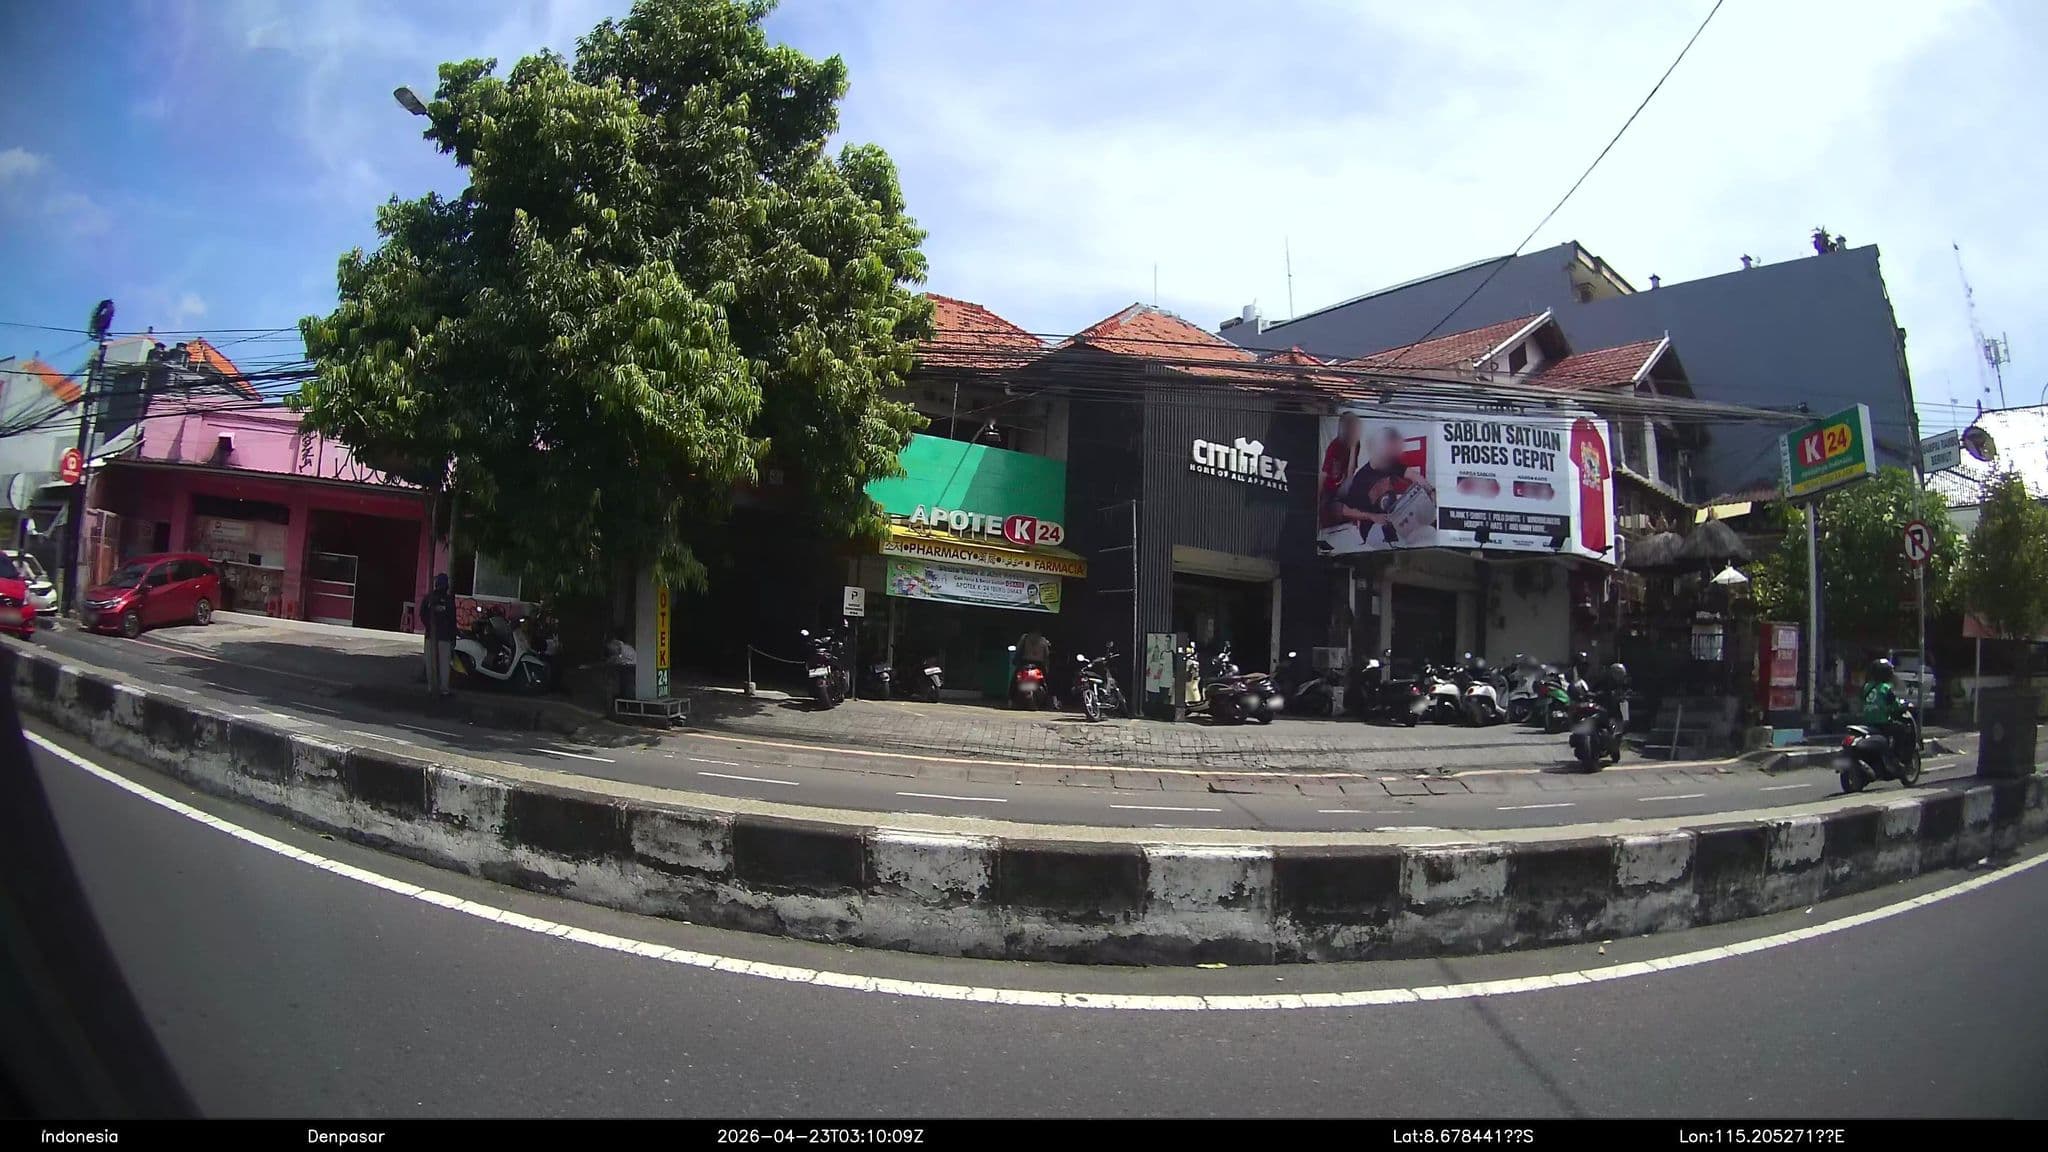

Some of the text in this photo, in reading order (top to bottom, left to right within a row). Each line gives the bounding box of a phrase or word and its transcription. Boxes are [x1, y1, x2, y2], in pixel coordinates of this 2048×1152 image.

[1444, 423, 1561, 451] SABLON SATUAN
[1451, 445, 1555, 472] PROSES CEPAT
[1190, 464, 1215, 475] HOME
[1231, 474, 1245, 482] ALL
[1247, 477, 1289, 491] APPAREL
[909, 543, 973, 562] PHARMACY
[1034, 559, 1083, 576] FARMACIA
[658, 670, 668, 685] 24
